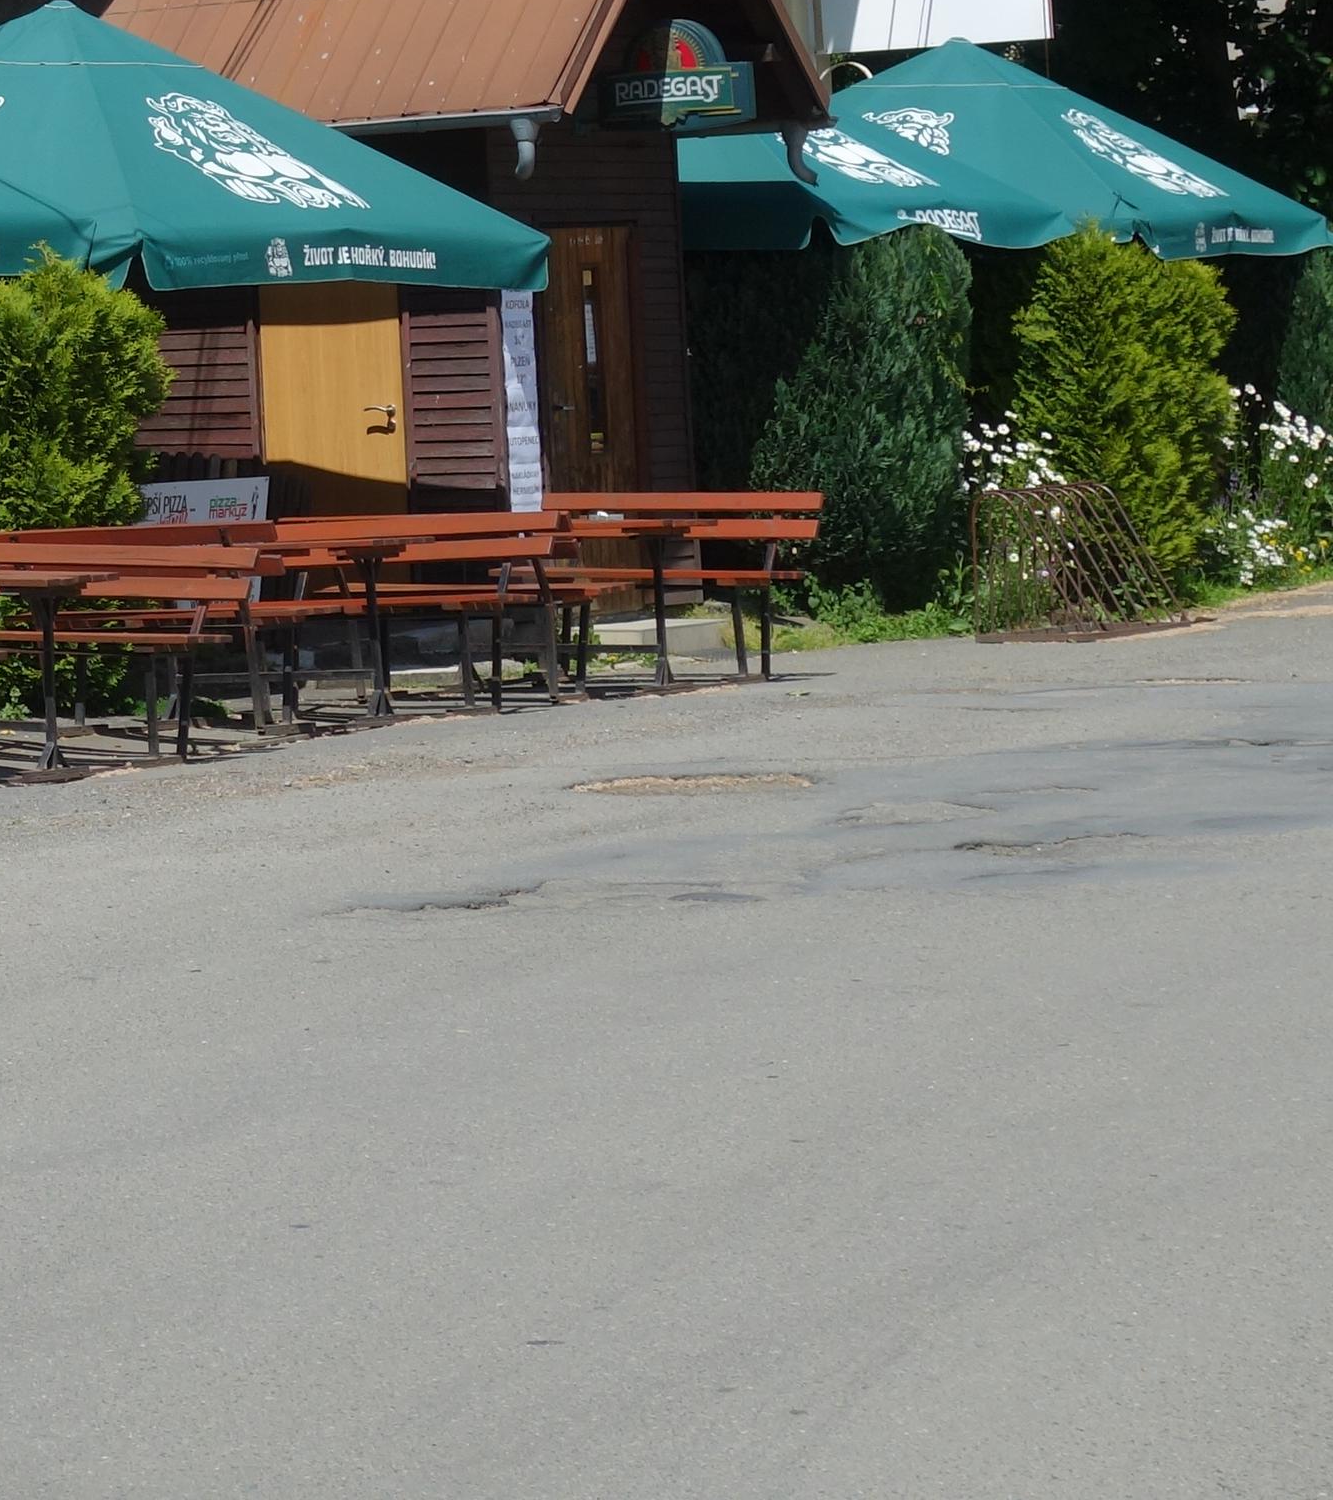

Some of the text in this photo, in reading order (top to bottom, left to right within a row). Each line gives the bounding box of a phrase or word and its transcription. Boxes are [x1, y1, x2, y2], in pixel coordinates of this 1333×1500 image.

[615, 74, 723, 106] RADEGAST
[303, 244, 437, 270] ŽIVOT JE HOŘKÝ. BOHUDÍK!
[505, 299, 530, 310] KOFOLA
[163, 494, 188, 514] PIZZA
[209, 496, 237, 508] pizza
